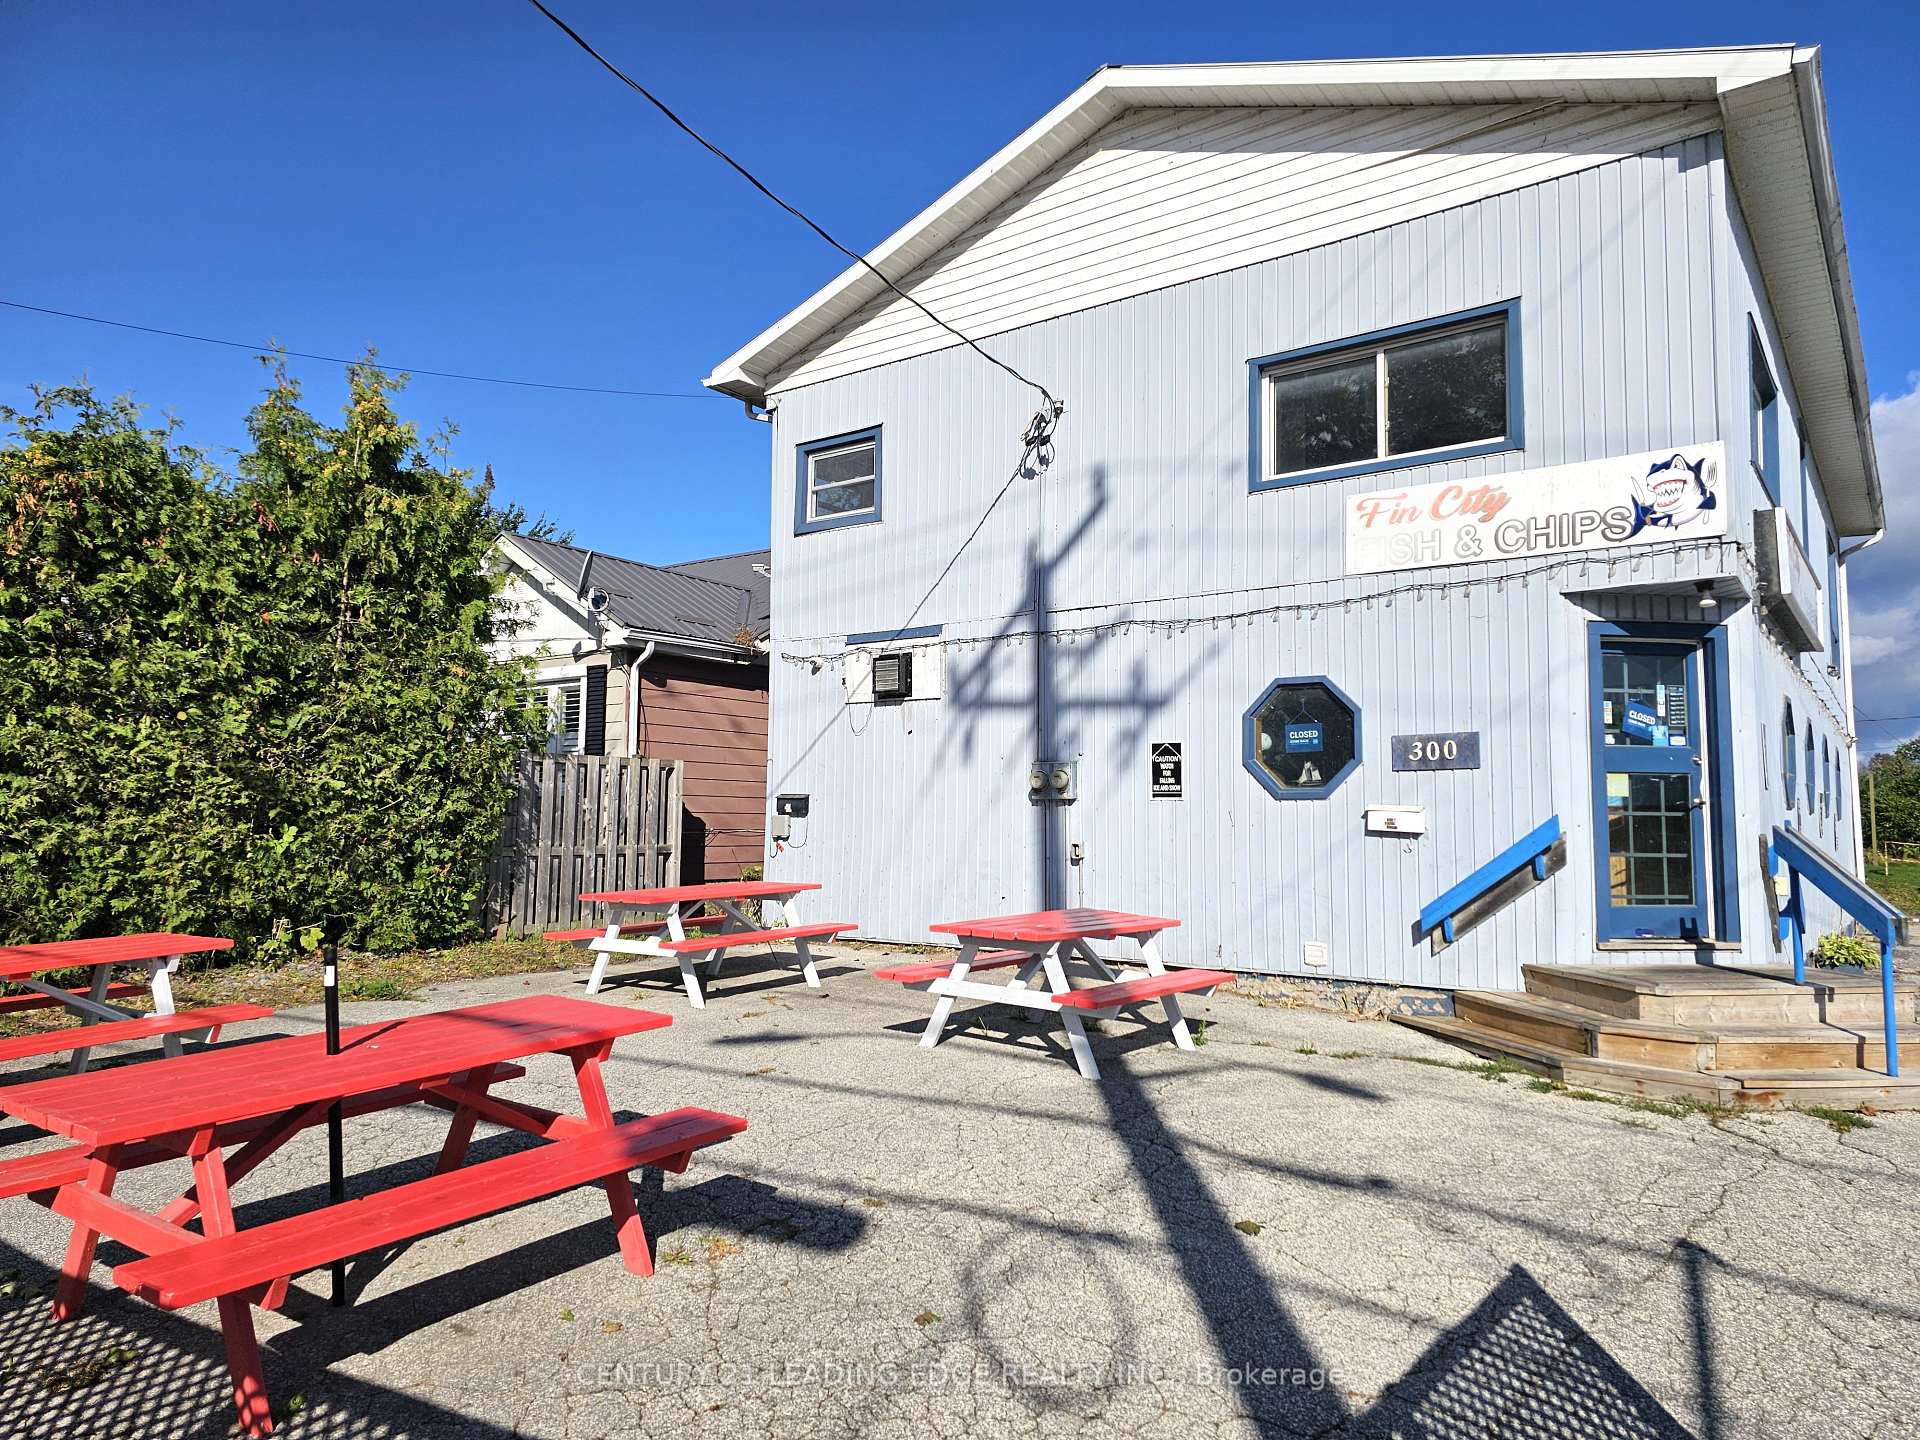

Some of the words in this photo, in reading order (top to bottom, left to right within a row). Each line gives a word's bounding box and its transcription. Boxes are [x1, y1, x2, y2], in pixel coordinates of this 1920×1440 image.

[1356, 493, 1421, 528] Fin
[1429, 484, 1512, 524] City
[1454, 524, 1484, 559] &
[1494, 505, 1634, 554] CHIPS
[1629, 710, 1655, 725] CLOSED
[1289, 730, 1319, 738] CLOSED
[1154, 755, 1179, 763] CAUTION
[1408, 740, 1458, 761] 300
